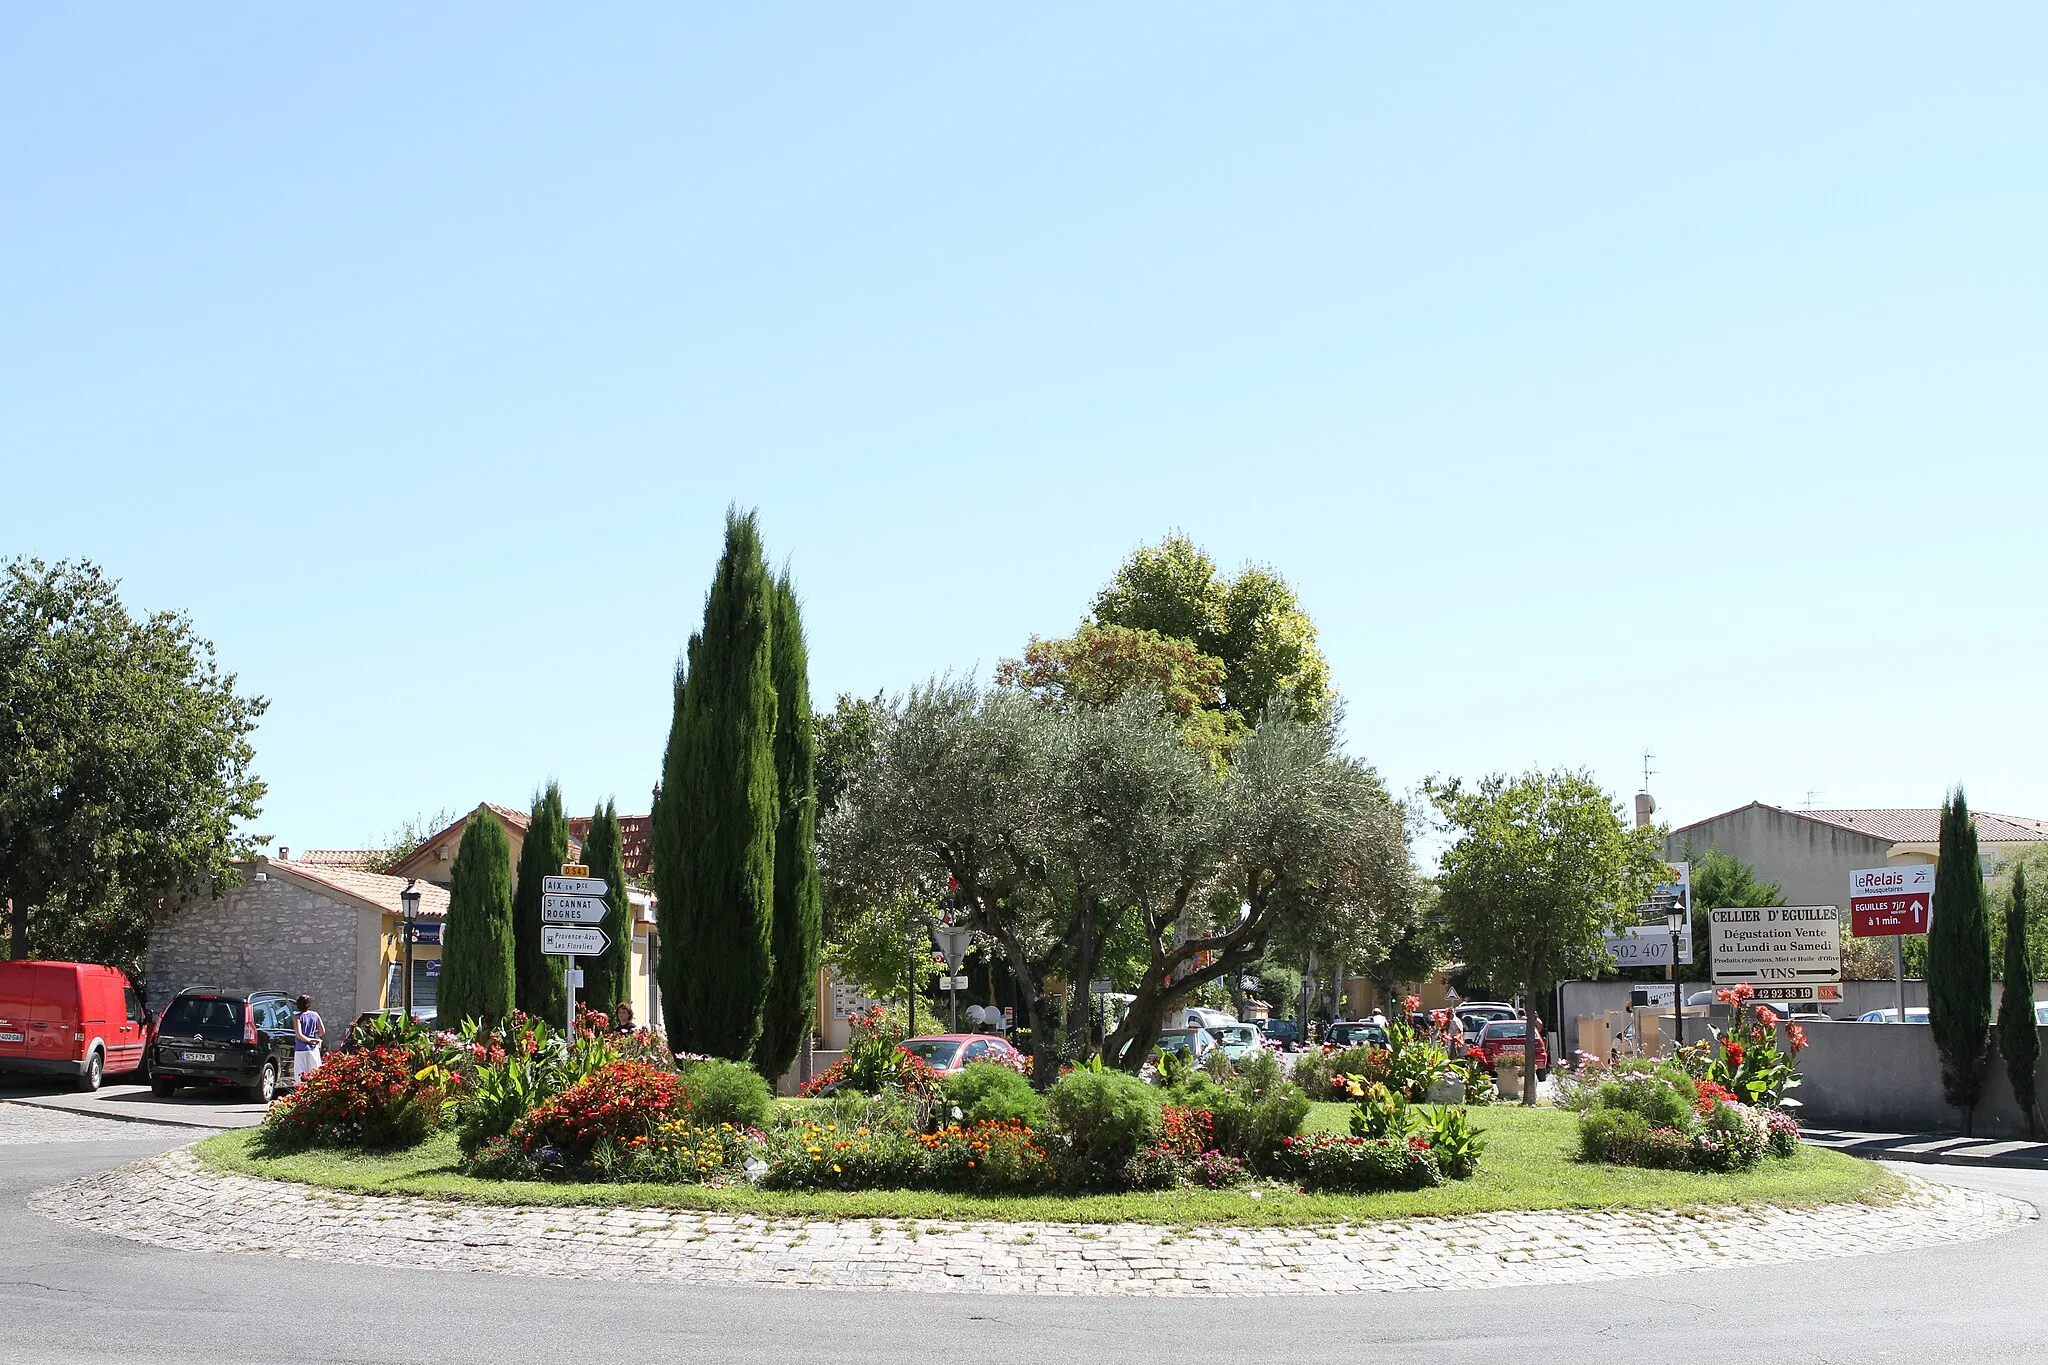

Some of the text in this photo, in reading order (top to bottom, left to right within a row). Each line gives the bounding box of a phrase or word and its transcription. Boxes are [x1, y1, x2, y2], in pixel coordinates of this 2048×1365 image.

[565, 867, 587, 876] D 543
[547, 881, 562, 890] AIX
[559, 900, 592, 909] CANNAT
[1855, 901, 1906, 912] EGUILLES 7j/7
[547, 910, 582, 919] ROGNES
[1712, 908, 1837, 923] CELLIER D' EGUILLES
[1868, 915, 1901, 926] à 1 min.
[555, 932, 598, 940] Provence-Azur
[1723, 928, 1827, 941] Dégustation Vente
[567, 942, 593, 950] Floralies
[1612, 943, 1668, 958] 502 407
[1719, 941, 1832, 953] du Lundi au Samedi
[1760, 967, 1796, 979] VINS
[1757, 989, 1769, 999] 42
[1771, 989, 1783, 998] 92
[1785, 988, 1797, 998] 38
[1800, 988, 1811, 998] 19
